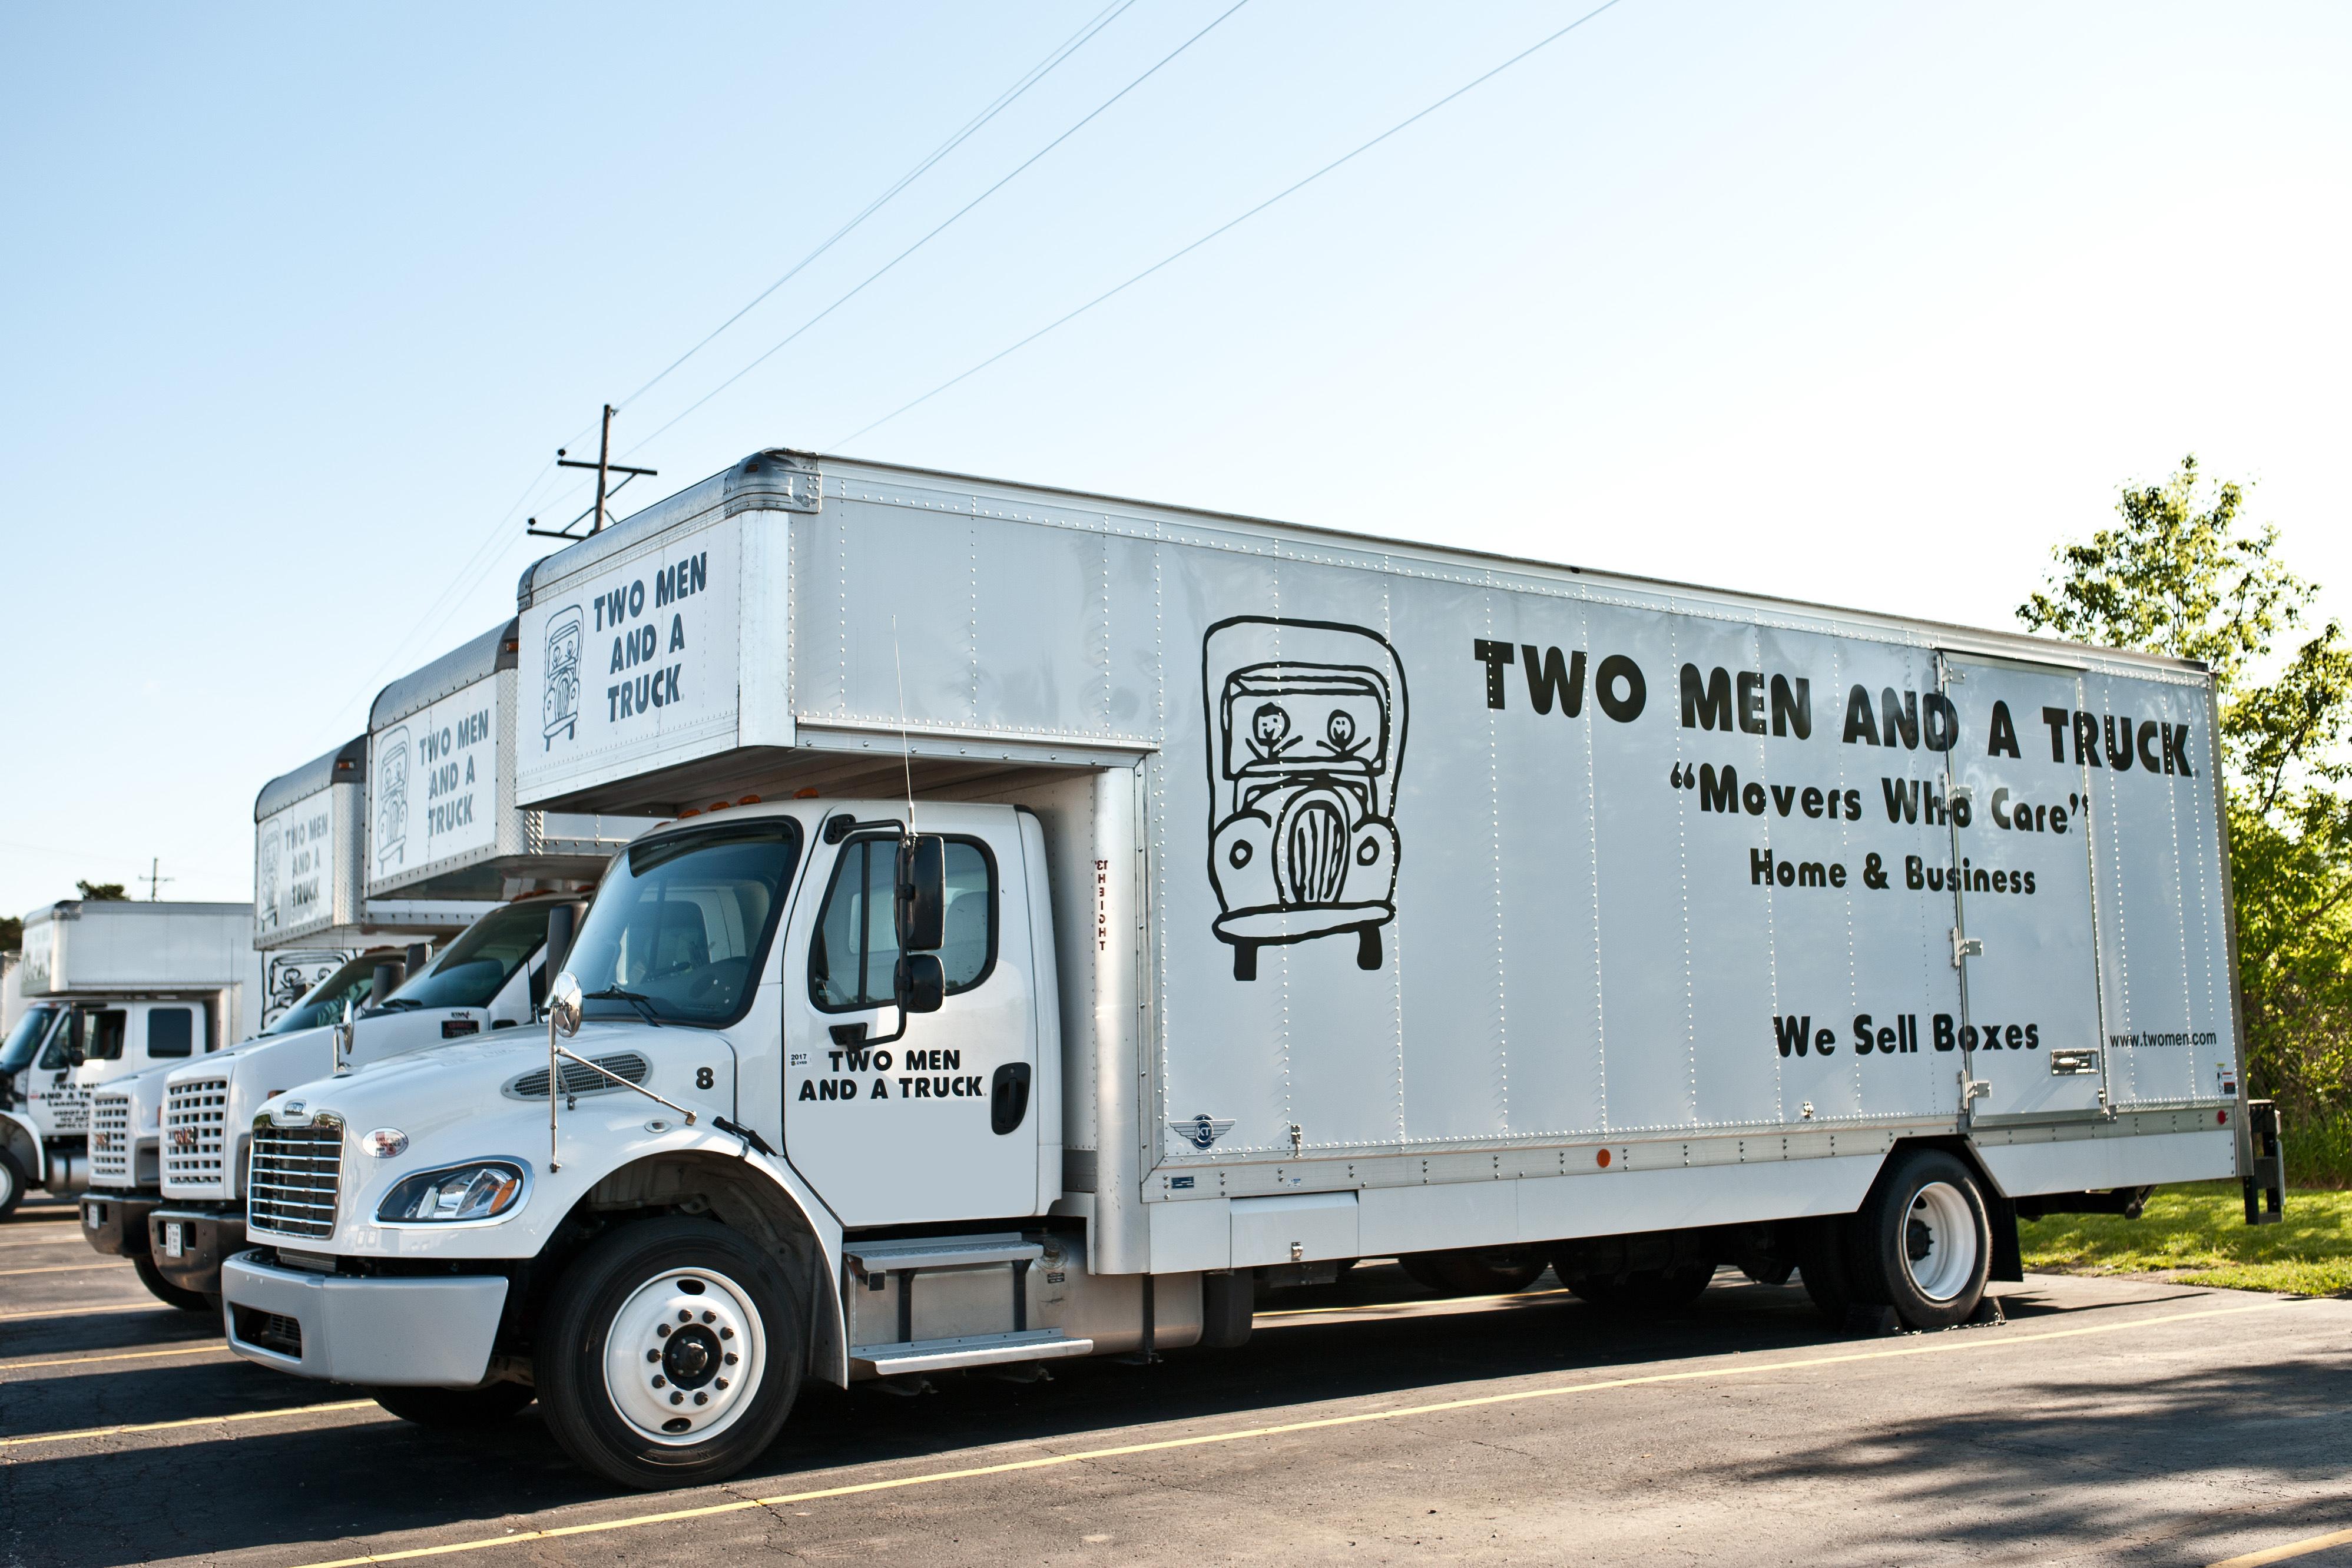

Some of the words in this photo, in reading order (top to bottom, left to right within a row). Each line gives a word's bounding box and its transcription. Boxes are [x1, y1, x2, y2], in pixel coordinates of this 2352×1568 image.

[594, 579, 645, 632] TWO
[655, 551, 707, 609] MEN
[609, 624, 657, 675] AND
[668, 613, 685, 654] A
[608, 663, 681, 723] TRUCK
[1474, 638, 1647, 723] TWO
[1679, 662, 1812, 741] MEN
[1842, 684, 1960, 752] AND
[1987, 700, 2022, 759] A
[2042, 706, 2193, 778] TRUCK
[419, 727, 451, 766] TWO
[458, 709, 489, 750] MEN
[429, 761, 459, 800] AND
[465, 754, 475, 785] A
[1670, 761, 1862, 821] “Movers
[1881, 777, 1972, 828] Who
[285, 823, 305, 851] TWO
[309, 812, 328, 841] MEN
[429, 794, 473, 837] TRUCK
[293, 851, 310, 878] AND
[314, 845, 320, 869] A
[1750, 848, 1847, 888] Home
[1863, 853, 1890, 890] &
[1905, 854, 2036, 895] Business
[292, 876, 319, 907] TRUCK
[1773, 1015, 1836, 1058] We
[1853, 1014, 1918, 1055] Sell
[1933, 1013, 2039, 1053] Boxes
[2109, 1031, 2217, 1047] www.twomen.com
[695, 1066, 714, 1090] 8
[828, 1050, 893, 1072] TWO
[906, 1049, 960, 1071] MEN
[799, 1079, 857, 1101] AND
[870, 1078, 889, 1099] A
[899, 1076, 983, 1098] TRUCK
[1197, 1127, 1211, 1136] KT
